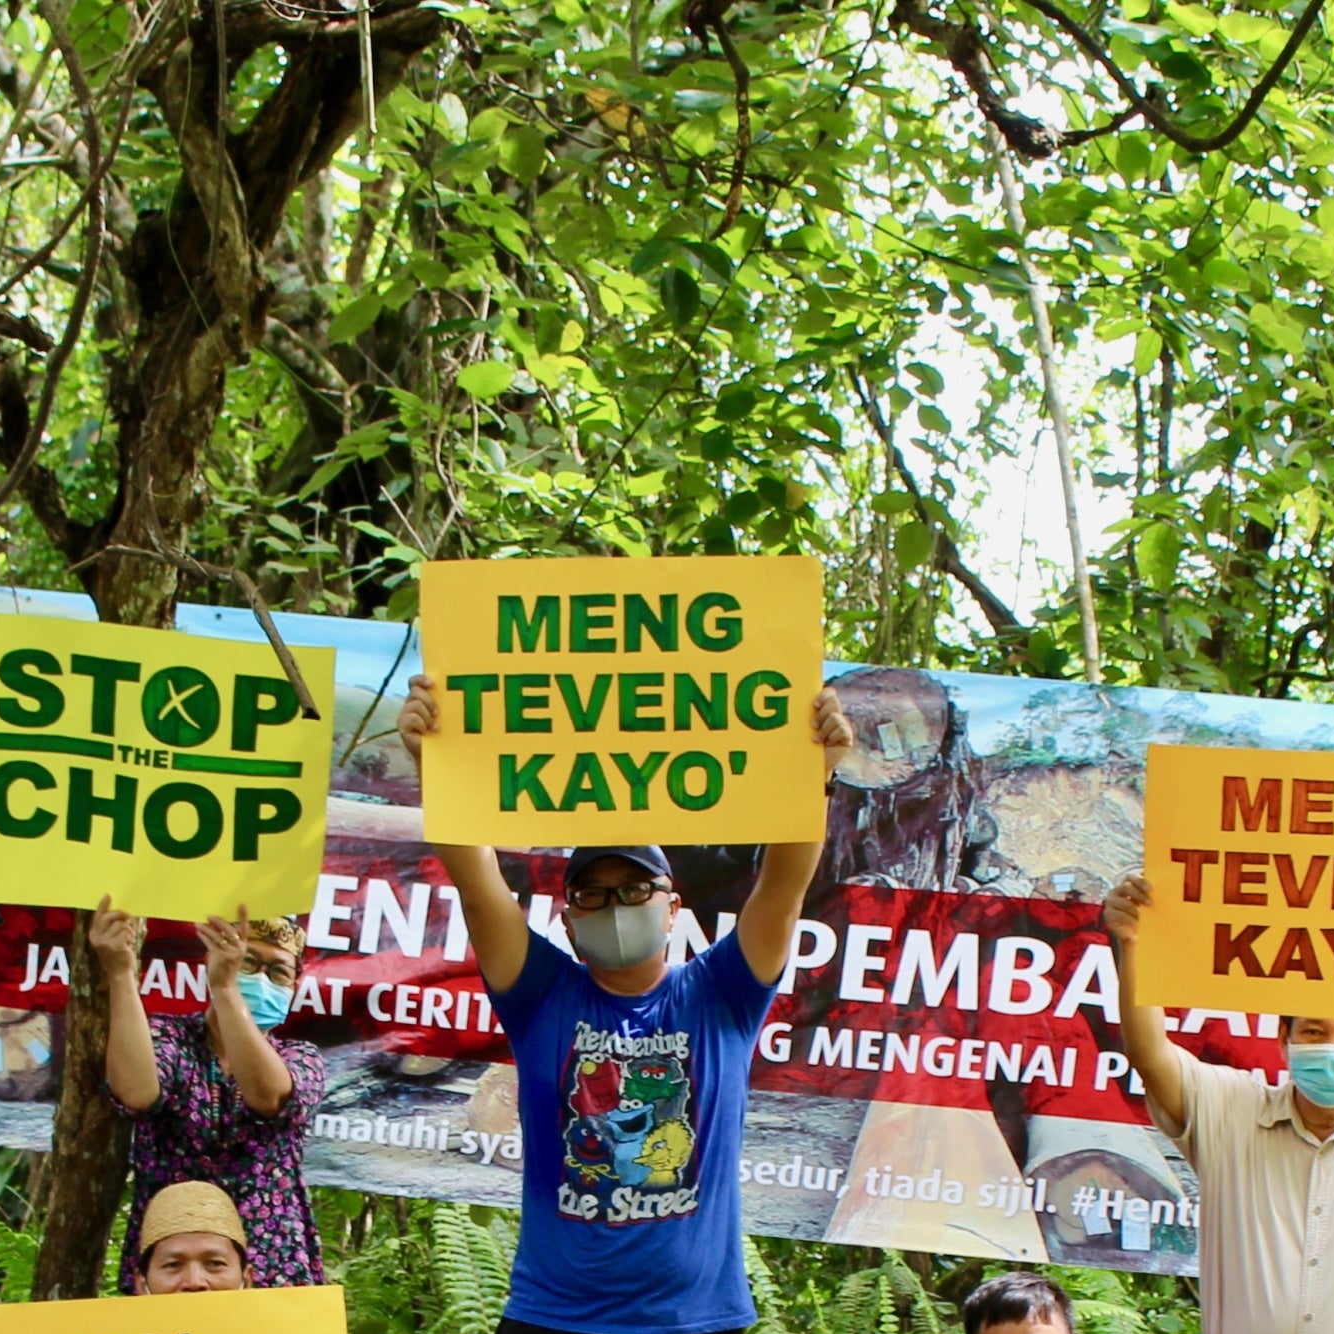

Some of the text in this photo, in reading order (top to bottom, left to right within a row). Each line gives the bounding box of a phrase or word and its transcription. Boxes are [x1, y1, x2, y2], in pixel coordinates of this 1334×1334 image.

[497, 592, 743, 654] MENG
[446, 670, 792, 735] TEVENG
[117, 745, 170, 770] THE
[499, 751, 747, 813] KAYO'
[367, 982, 505, 1034] CERIT
[807, 1026, 1077, 1088] MENGENAI
[607, 1185, 699, 1222] Street
[866, 1165, 964, 1205] tiada
[977, 1175, 1057, 1217] sijil.
